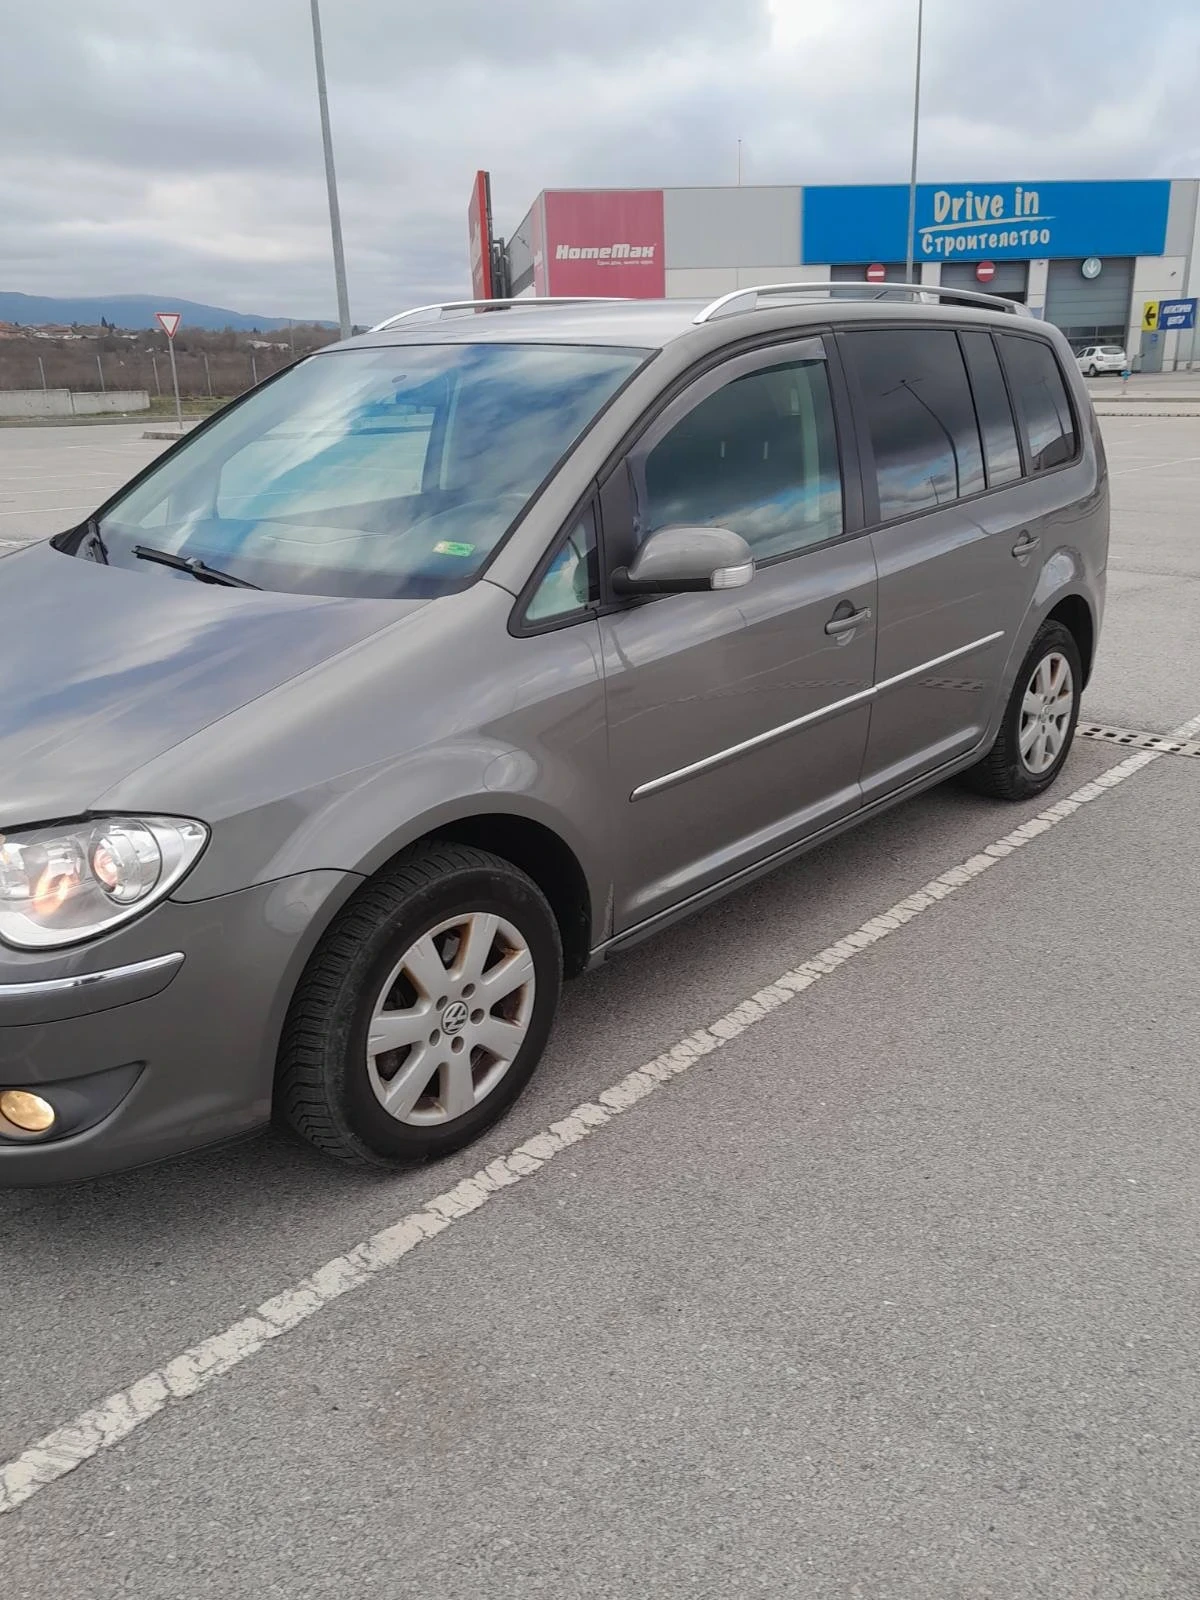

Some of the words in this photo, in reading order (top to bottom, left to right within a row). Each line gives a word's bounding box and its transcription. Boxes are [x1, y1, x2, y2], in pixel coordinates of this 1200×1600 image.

[934, 190, 1004, 223] Drive
[1015, 186, 1039, 216] in
[555, 243, 655, 259] HomeMax
[922, 229, 1051, 257] Строителство
